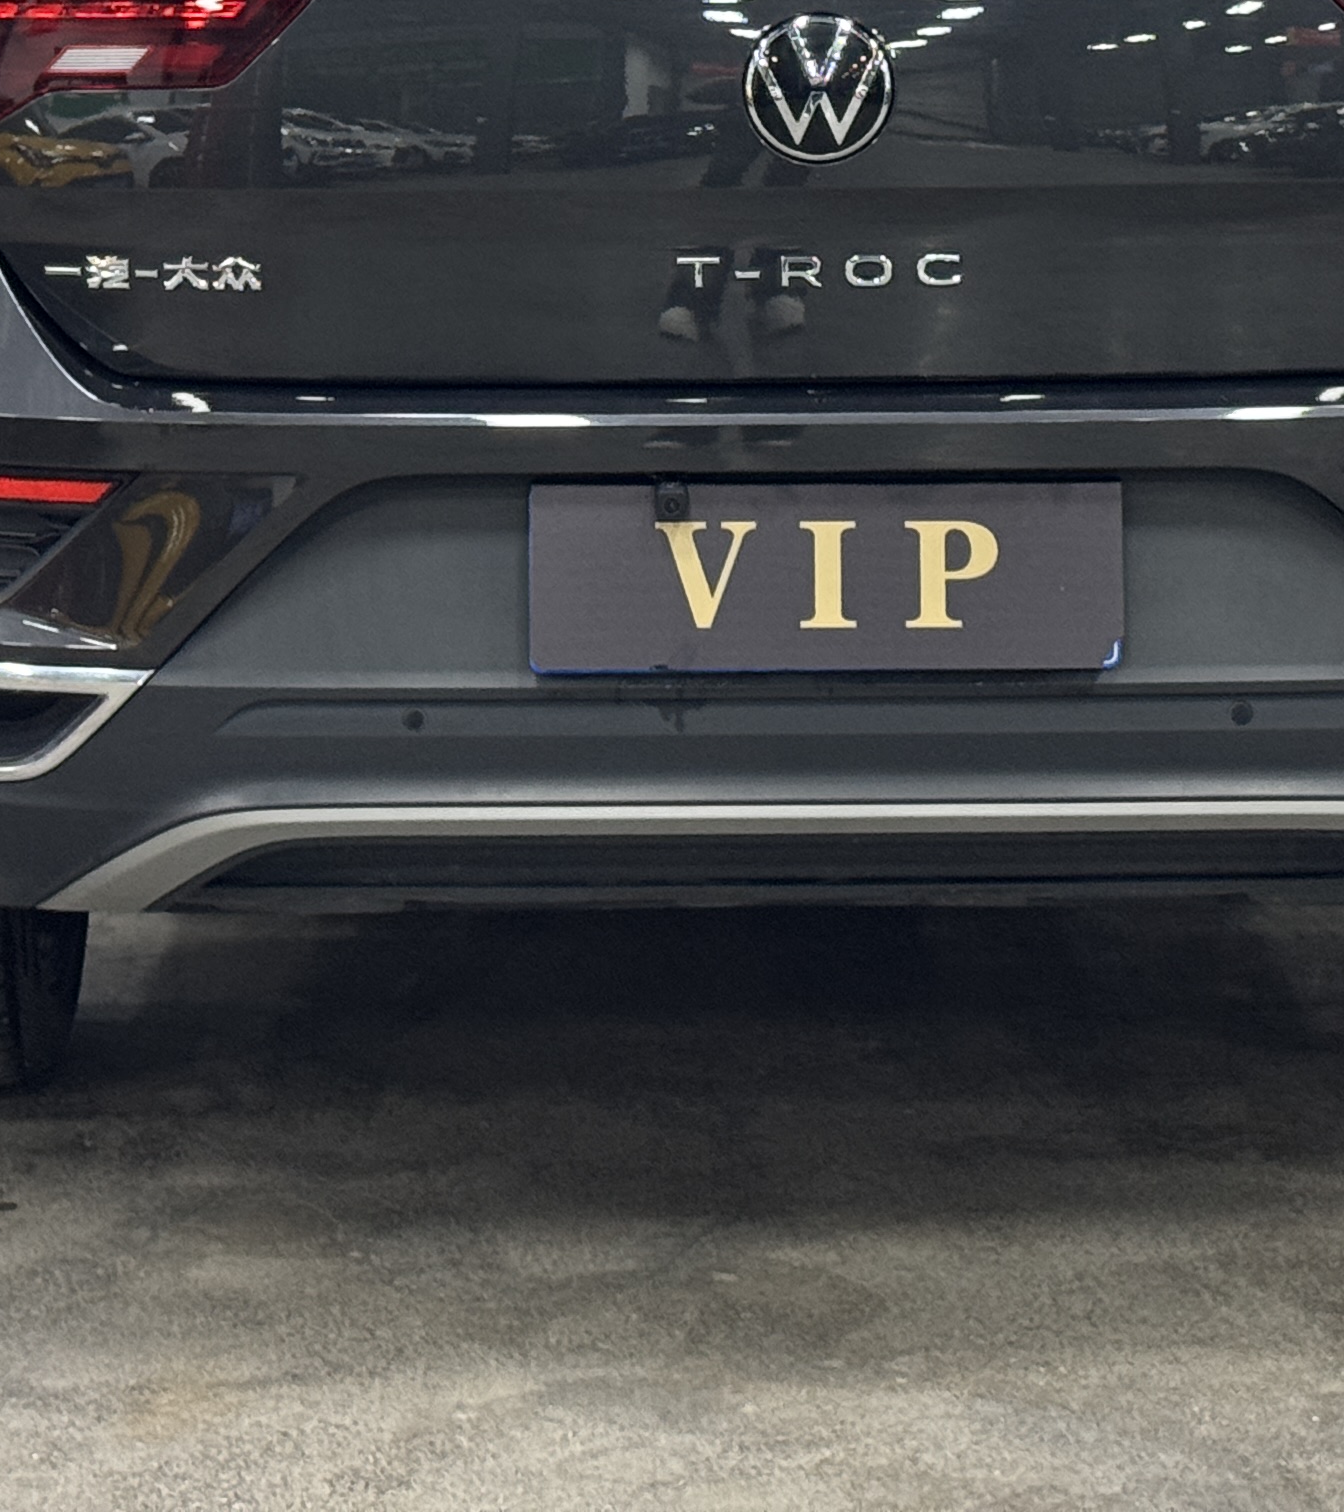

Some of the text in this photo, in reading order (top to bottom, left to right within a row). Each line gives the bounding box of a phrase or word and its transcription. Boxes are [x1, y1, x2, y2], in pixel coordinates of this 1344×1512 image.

[43, 254, 262, 291] 一汽-大众
[654, 520, 1000, 629] VIP
